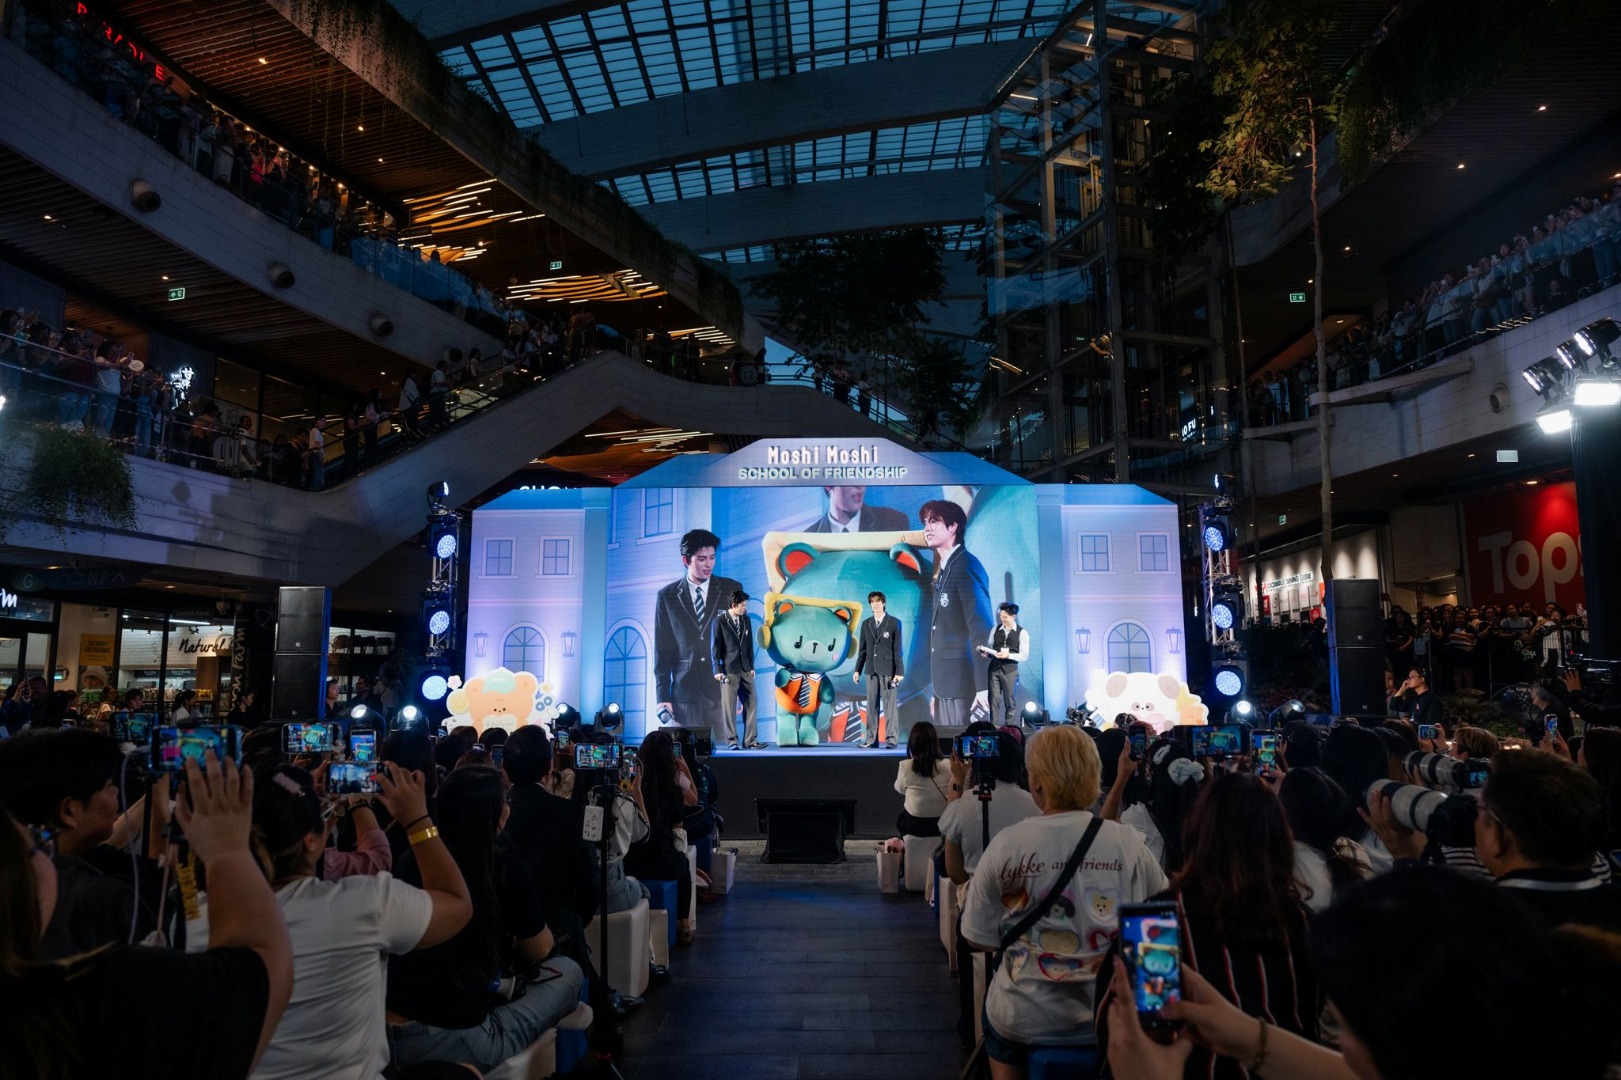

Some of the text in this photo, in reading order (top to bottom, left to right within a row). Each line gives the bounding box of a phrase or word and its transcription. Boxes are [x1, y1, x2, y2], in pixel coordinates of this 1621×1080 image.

[767, 445, 878, 465] Moshi Moshi
[738, 466, 908, 480] SCHOOL OF FRIENDSHIP
[1478, 530, 1584, 602] Top
[179, 637, 226, 654] Natural
[233, 626, 246, 670] Farm
[999, 852, 1046, 889] lykke
